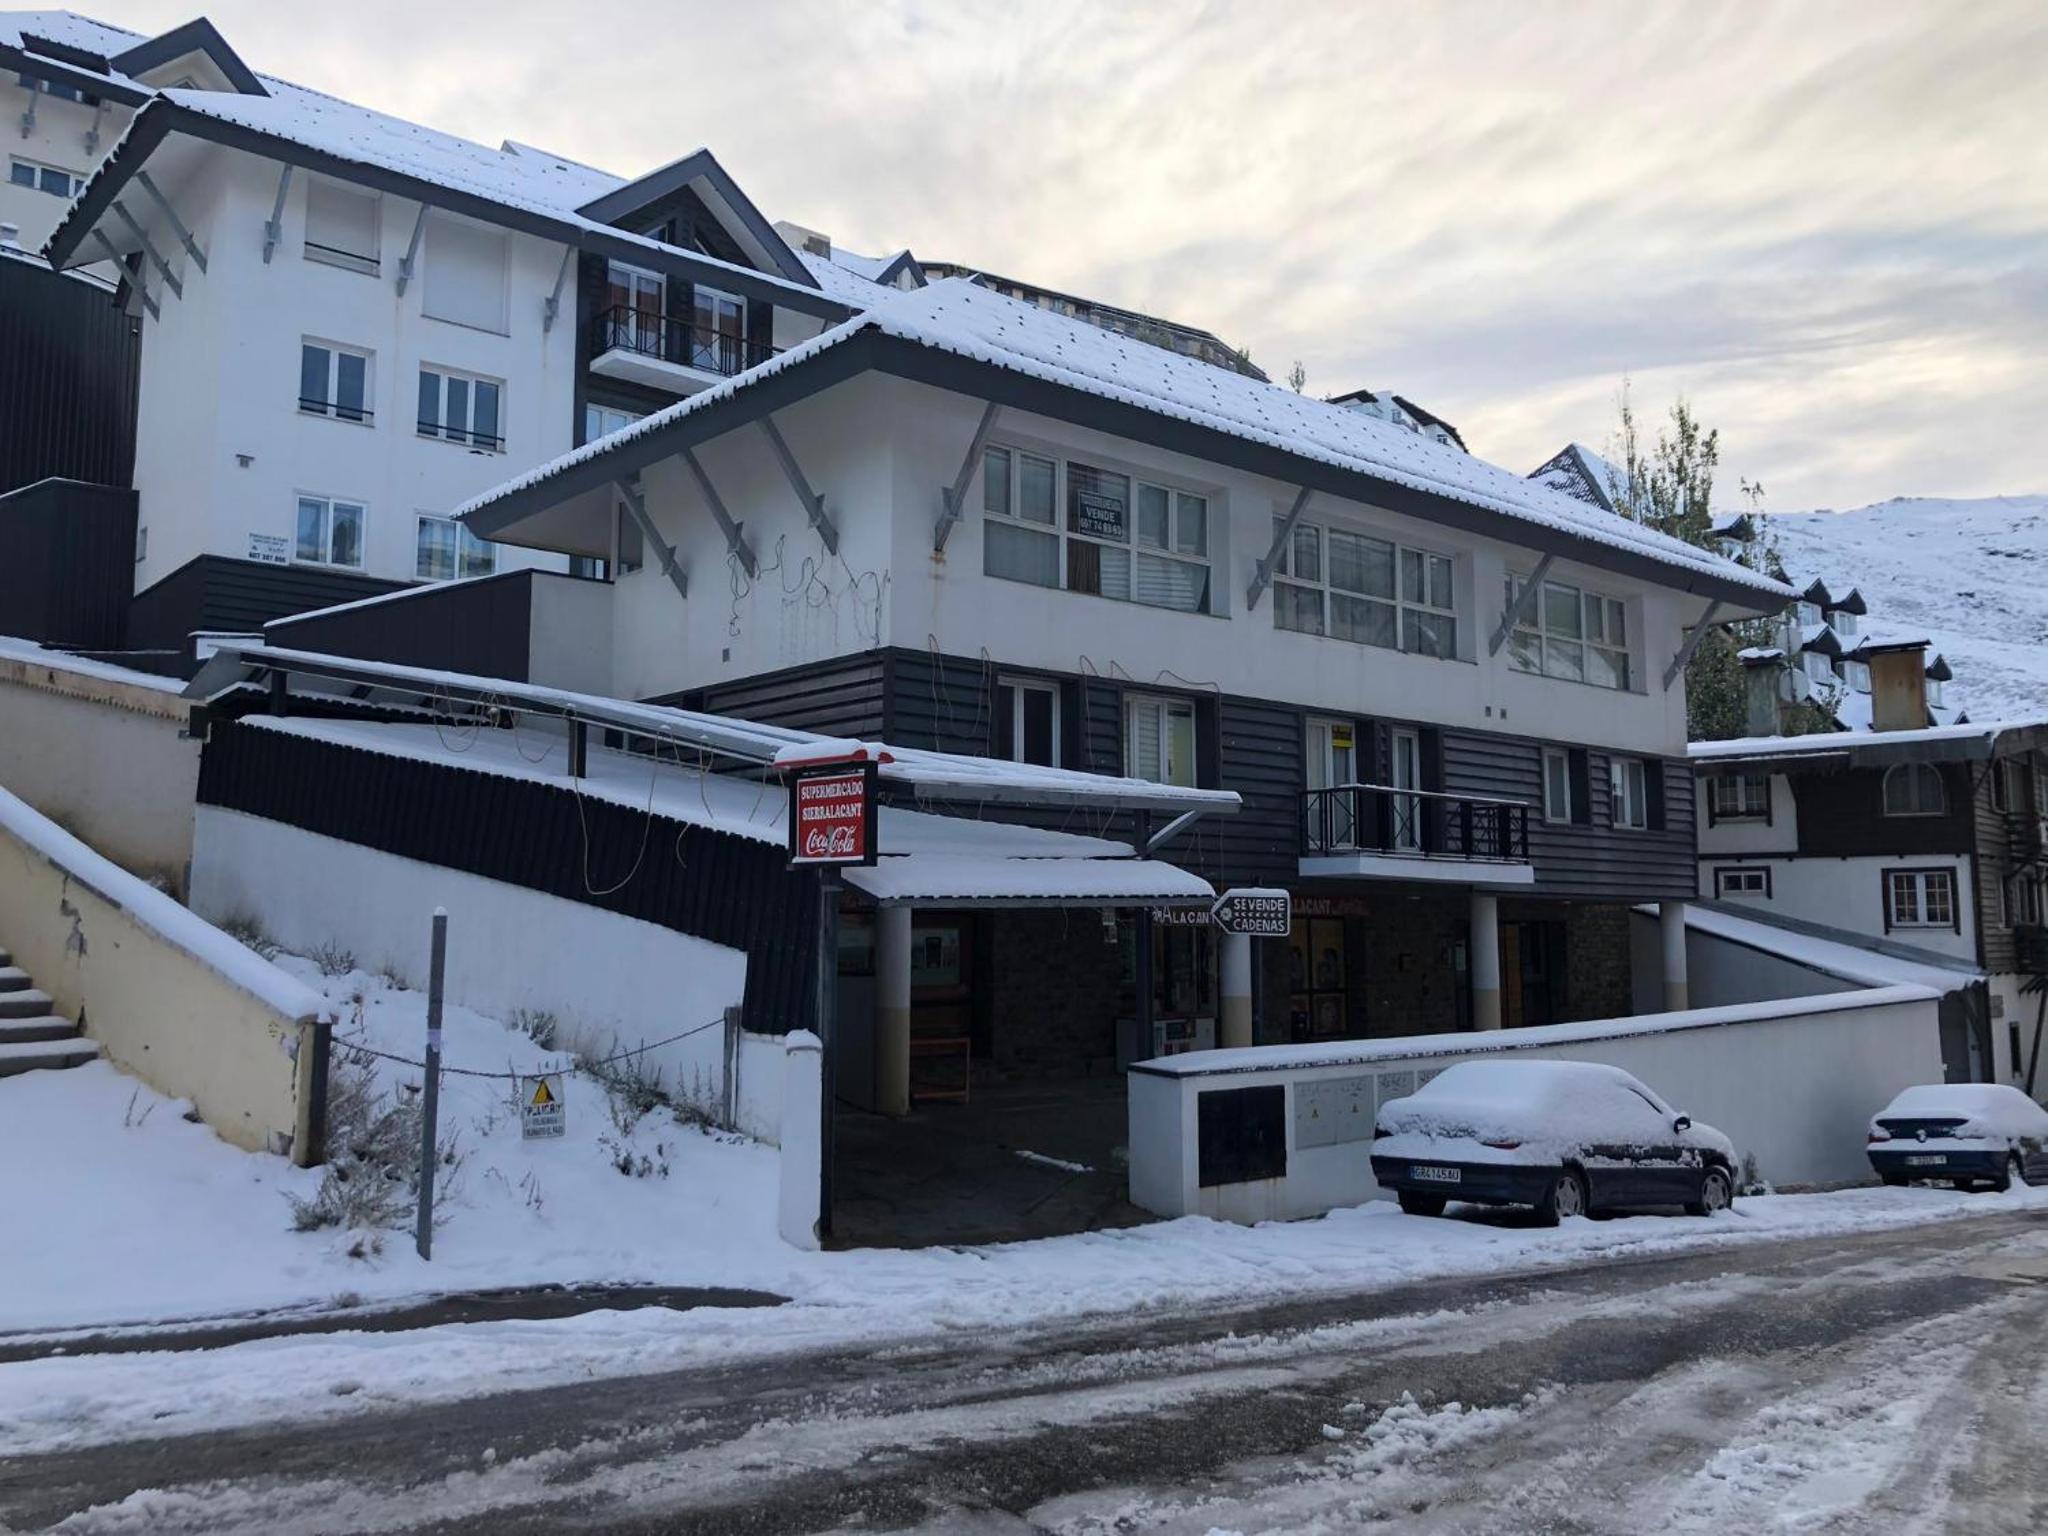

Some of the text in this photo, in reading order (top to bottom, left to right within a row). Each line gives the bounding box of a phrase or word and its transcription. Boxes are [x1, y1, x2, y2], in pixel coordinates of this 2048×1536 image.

[1086, 506, 1116, 522] VENDE
[801, 781, 864, 800] SUPERMERCADO
[803, 802, 862, 821] SIERRALACANT
[1233, 918, 1285, 932] CADENAS
